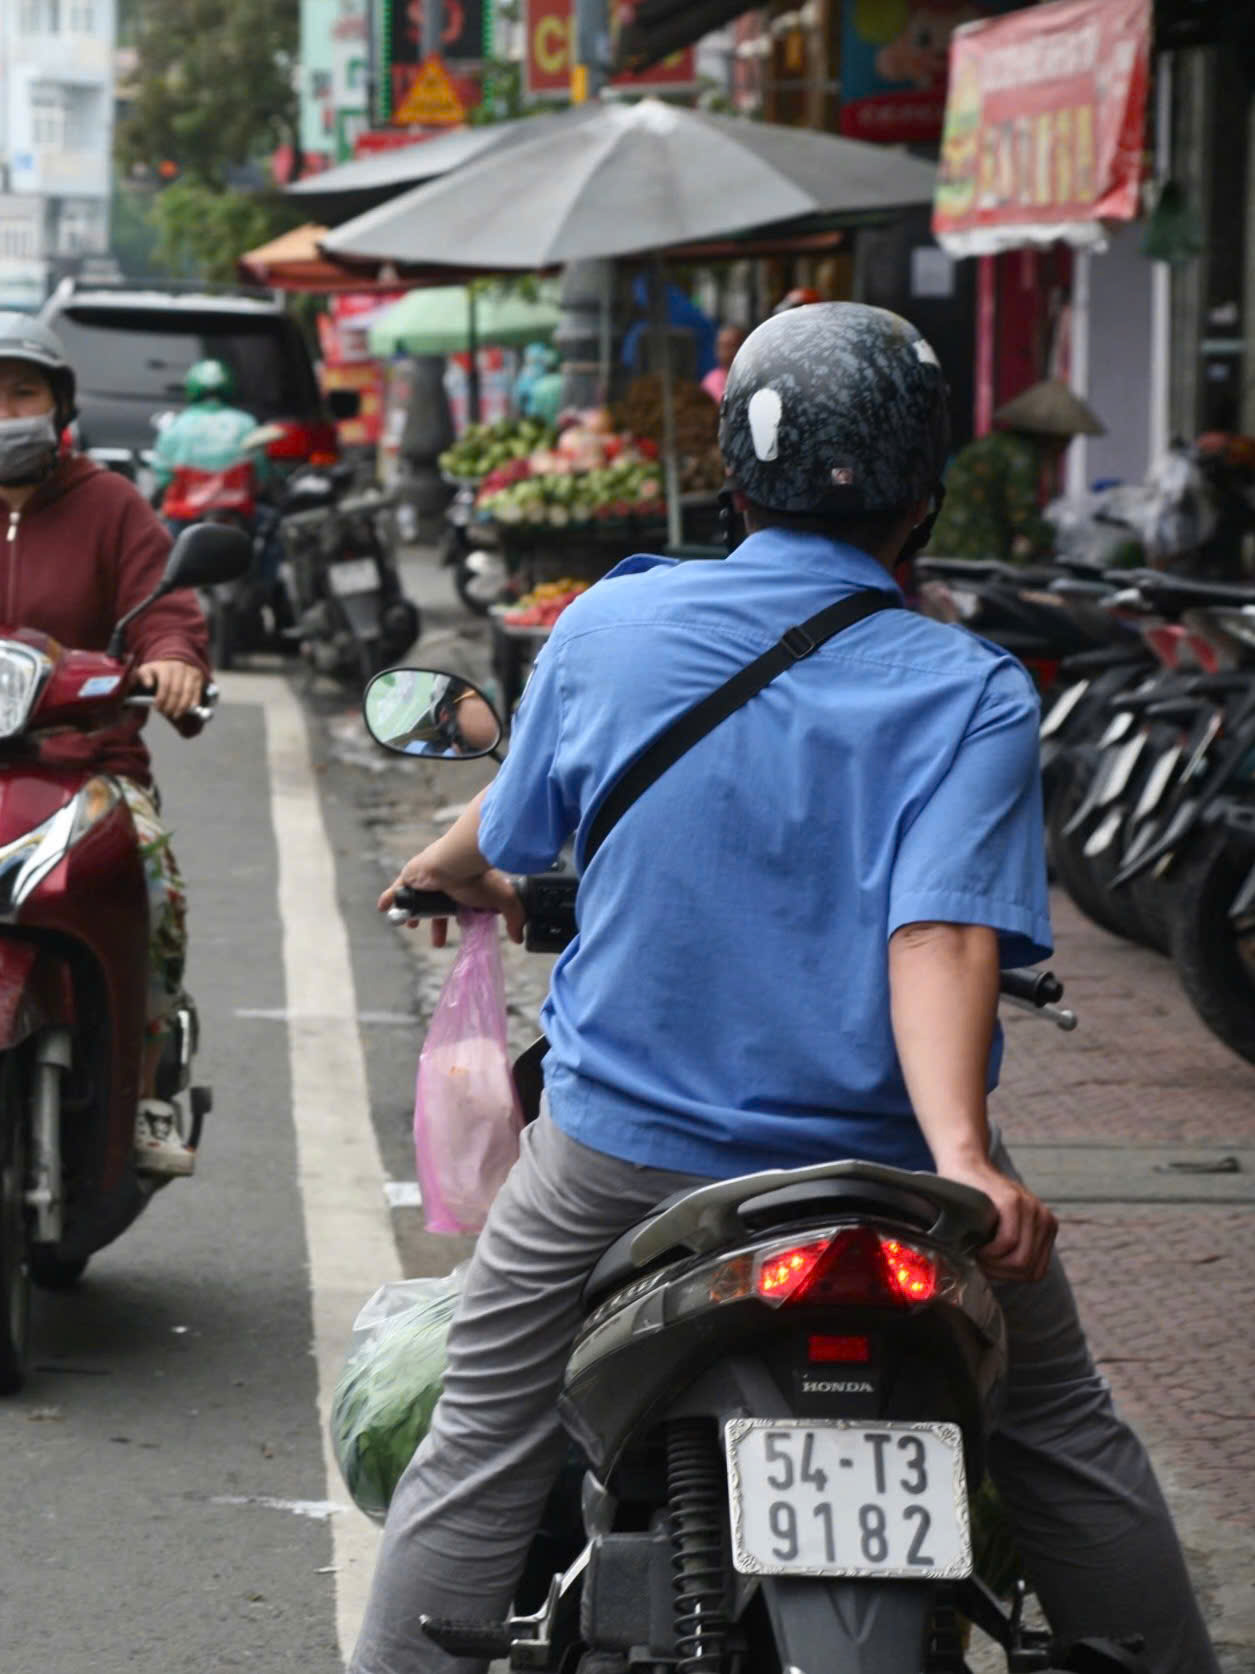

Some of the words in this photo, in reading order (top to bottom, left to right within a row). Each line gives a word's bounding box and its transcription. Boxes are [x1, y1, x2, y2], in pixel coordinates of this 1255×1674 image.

[802, 1381, 874, 1393] HONDA
[765, 1431, 928, 1495] 54-T3
[768, 1500, 935, 1567] 9182
